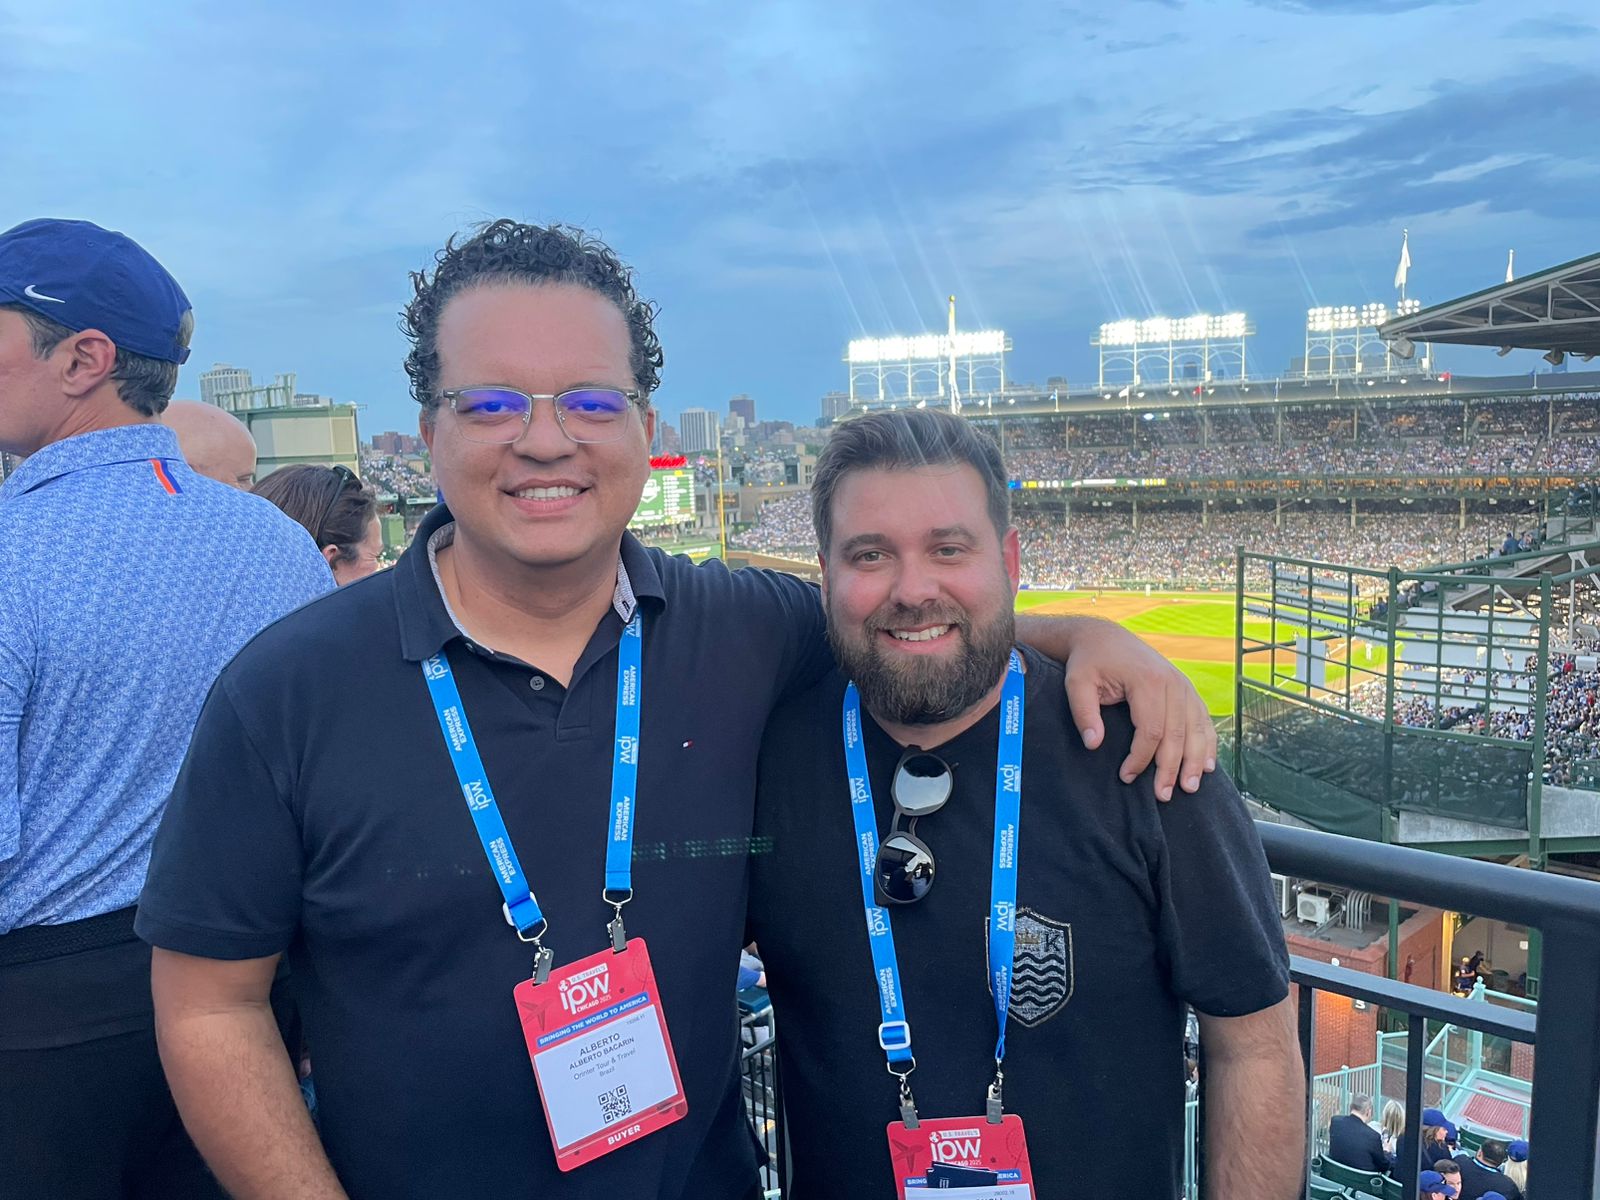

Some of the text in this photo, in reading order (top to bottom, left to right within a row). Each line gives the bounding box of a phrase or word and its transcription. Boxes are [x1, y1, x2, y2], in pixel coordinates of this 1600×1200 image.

[429, 654, 449, 680] ipw
[622, 669, 630, 706] EXPRESS
[629, 665, 637, 706] AMERICAN
[443, 709, 463, 752] AMERICAN
[449, 705, 467, 744] EXPRESS
[1005, 699, 1013, 735] EXPRESS
[617, 735, 633, 764] ipw
[469, 779, 492, 811] ipw
[855, 776, 870, 803] ipw
[1000, 764, 1015, 792] ipw
[614, 802, 624, 842] EXPRESS
[621, 796, 631, 841] AMERICAN
[488, 840, 513, 884] AMERICAN
[496, 836, 517, 876] EXPRESS
[860, 832, 872, 876] AMERICAN
[867, 831, 876, 869] EXPRESS
[999, 830, 1008, 869] EXPRESS
[1006, 823, 1014, 869] AMERICAN
[872, 906, 889, 936] ipw
[994, 901, 1009, 932] ipw
[1044, 933, 1061, 952] K
[558, 972, 611, 1014] ipw
[577, 994, 612, 1012] CHICAGO 2025
[879, 968, 893, 1015] AMERICAN
[885, 966, 898, 1008] EXPRESS
[539, 1027, 571, 1045] BRINGING
[571, 1021, 585, 1032] THE
[585, 1012, 609, 1027] WORLD
[609, 1007, 619, 1016] TO
[619, 996, 648, 1013] AMERICA
[569, 1037, 635, 1070] ALBERTO BACARIN
[580, 1032, 621, 1056] ALBERTO
[596, 1060, 609, 1069] Tour
[617, 1048, 636, 1061] Travel
[599, 1066, 615, 1077] Brazil
[607, 1124, 641, 1145] BUYER
[929, 1131, 981, 1163] ipw
